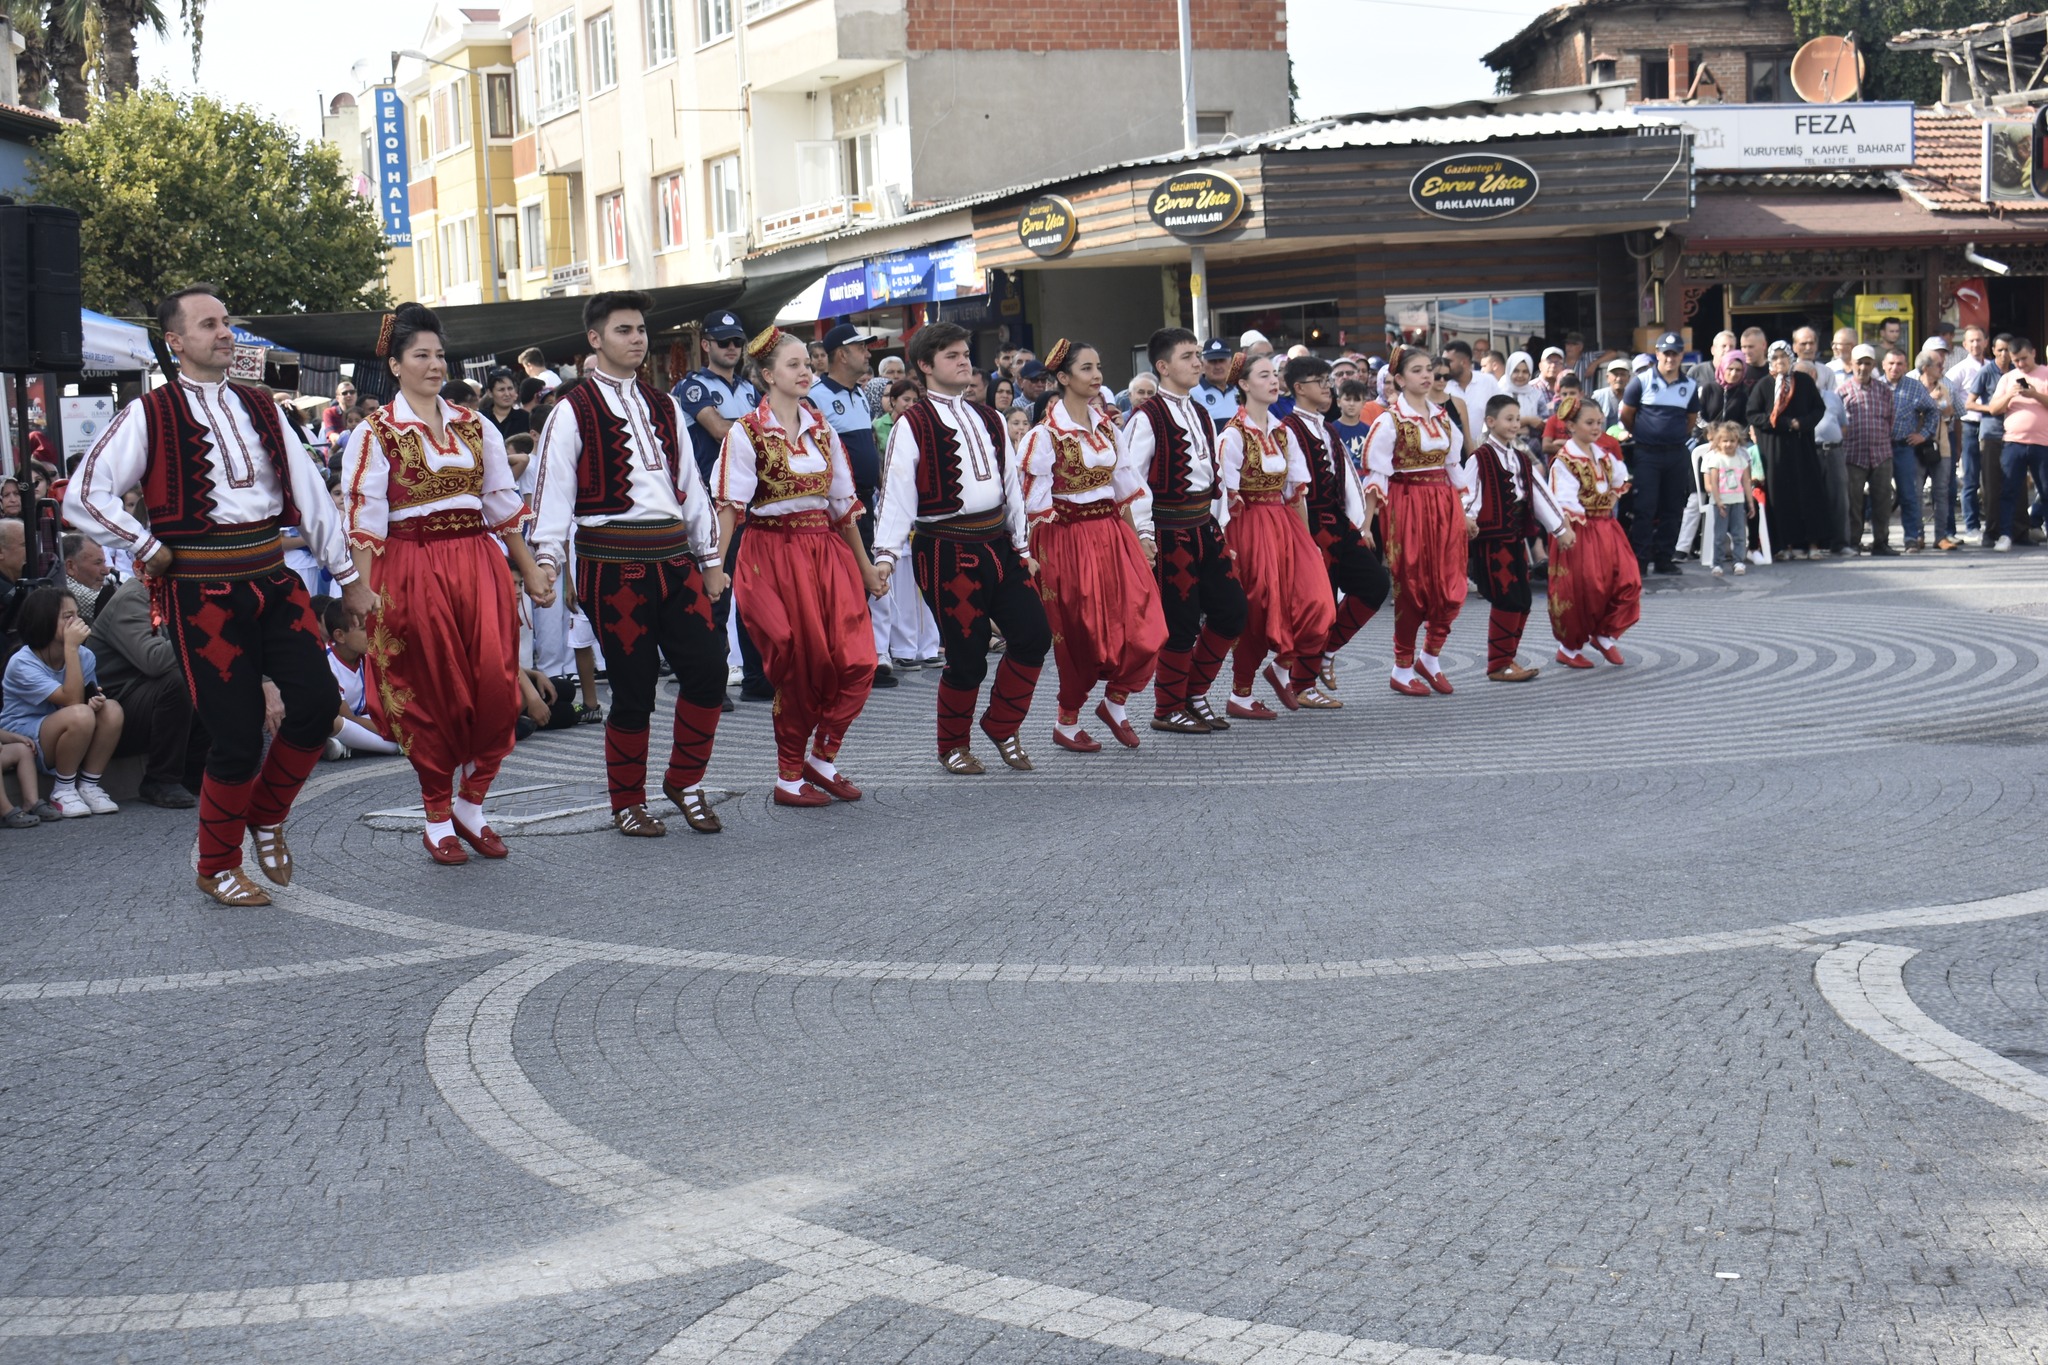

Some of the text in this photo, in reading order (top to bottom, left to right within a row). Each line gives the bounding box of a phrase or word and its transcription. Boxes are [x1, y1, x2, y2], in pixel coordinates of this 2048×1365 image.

[1794, 114, 1856, 135] FEZA
[1743, 143, 1907, 159] KURUYEMİŞ KAHVE BAHARAT
[383, 91, 402, 229] DEKOR HALI
[1444, 162, 1503, 175] Gaziantep'li
[1169, 178, 1213, 193] Gaziantep'li
[1420, 174, 1528, 197] Evren Usta
[1154, 189, 1231, 215] Evren Usta
[1435, 197, 1515, 210] BAKLAVALARI
[1021, 213, 1065, 237] Evren Usta
[1164, 211, 1223, 227] BAKLAVALARI
[1028, 233, 1062, 248] BAKLAVALARI
